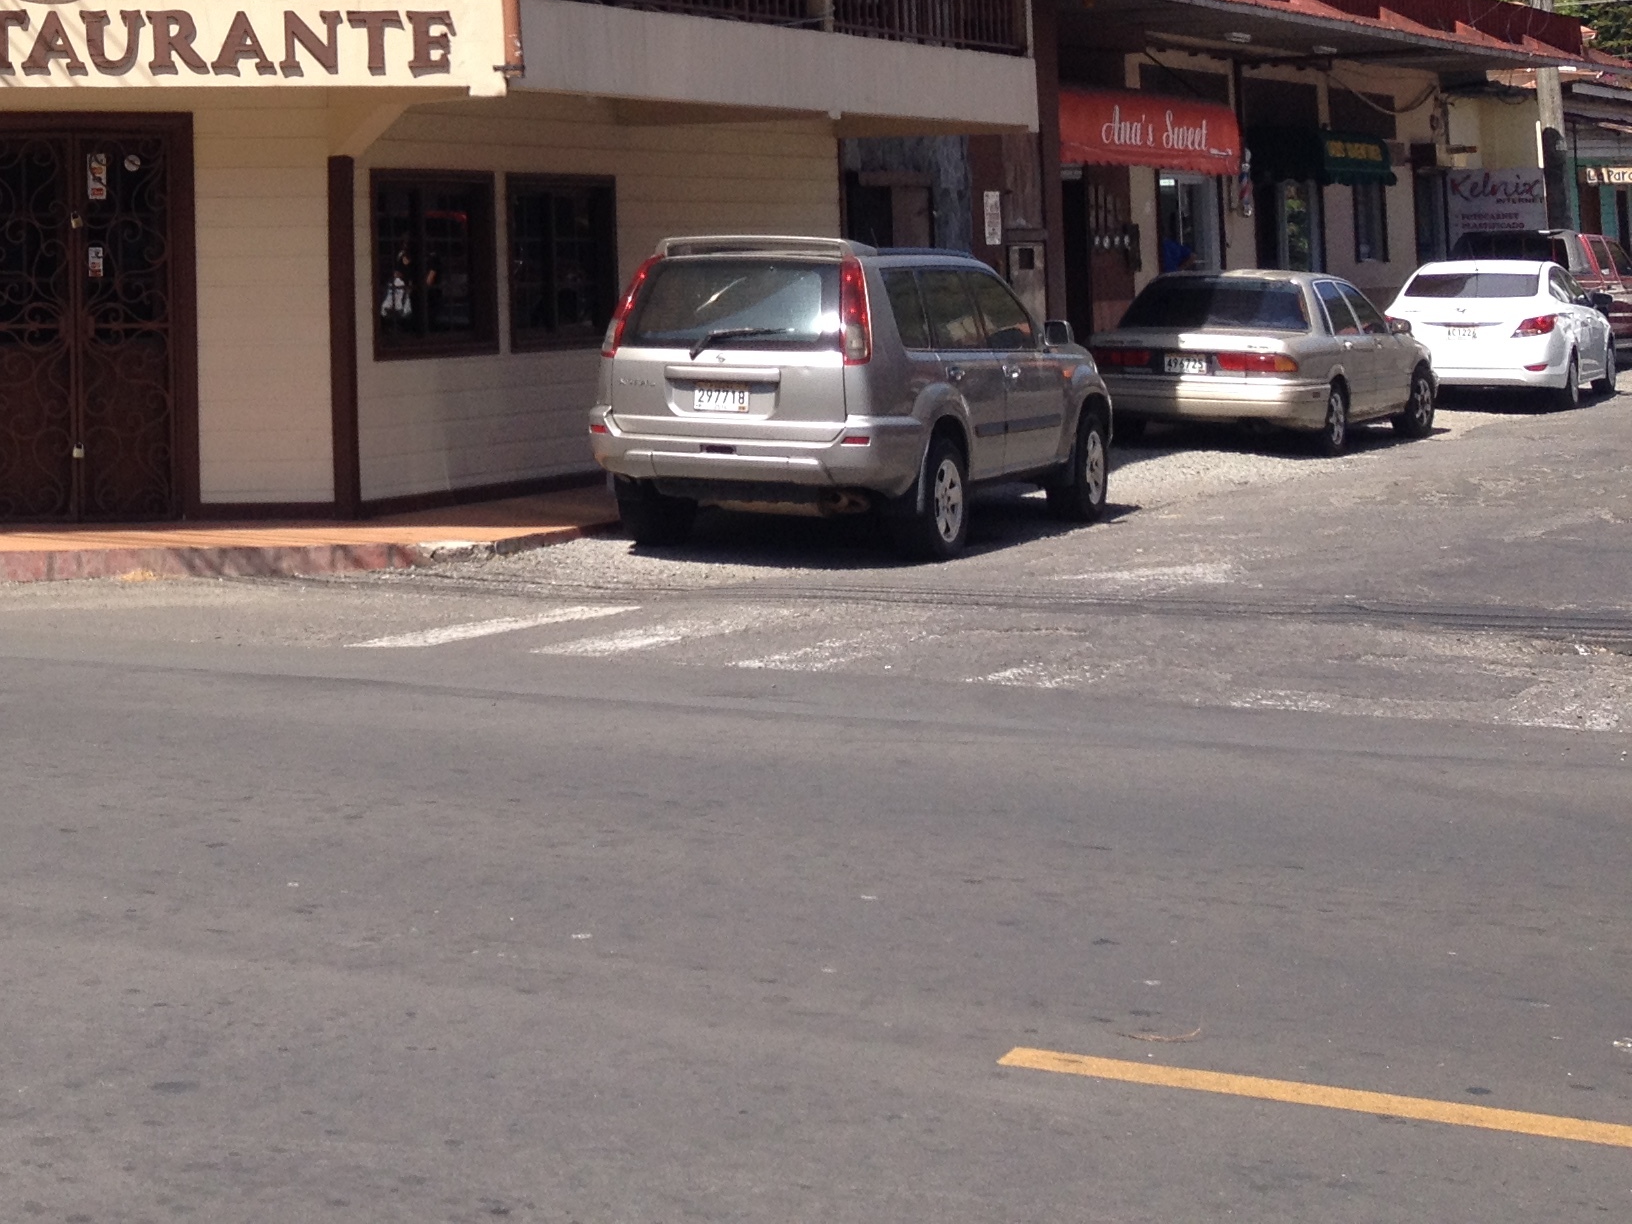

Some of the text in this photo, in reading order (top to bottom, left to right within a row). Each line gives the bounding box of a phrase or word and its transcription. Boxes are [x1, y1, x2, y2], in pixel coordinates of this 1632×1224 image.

[1102, 105, 1208, 150] Ana's Sweet
[698, 388, 744, 404] 297718
